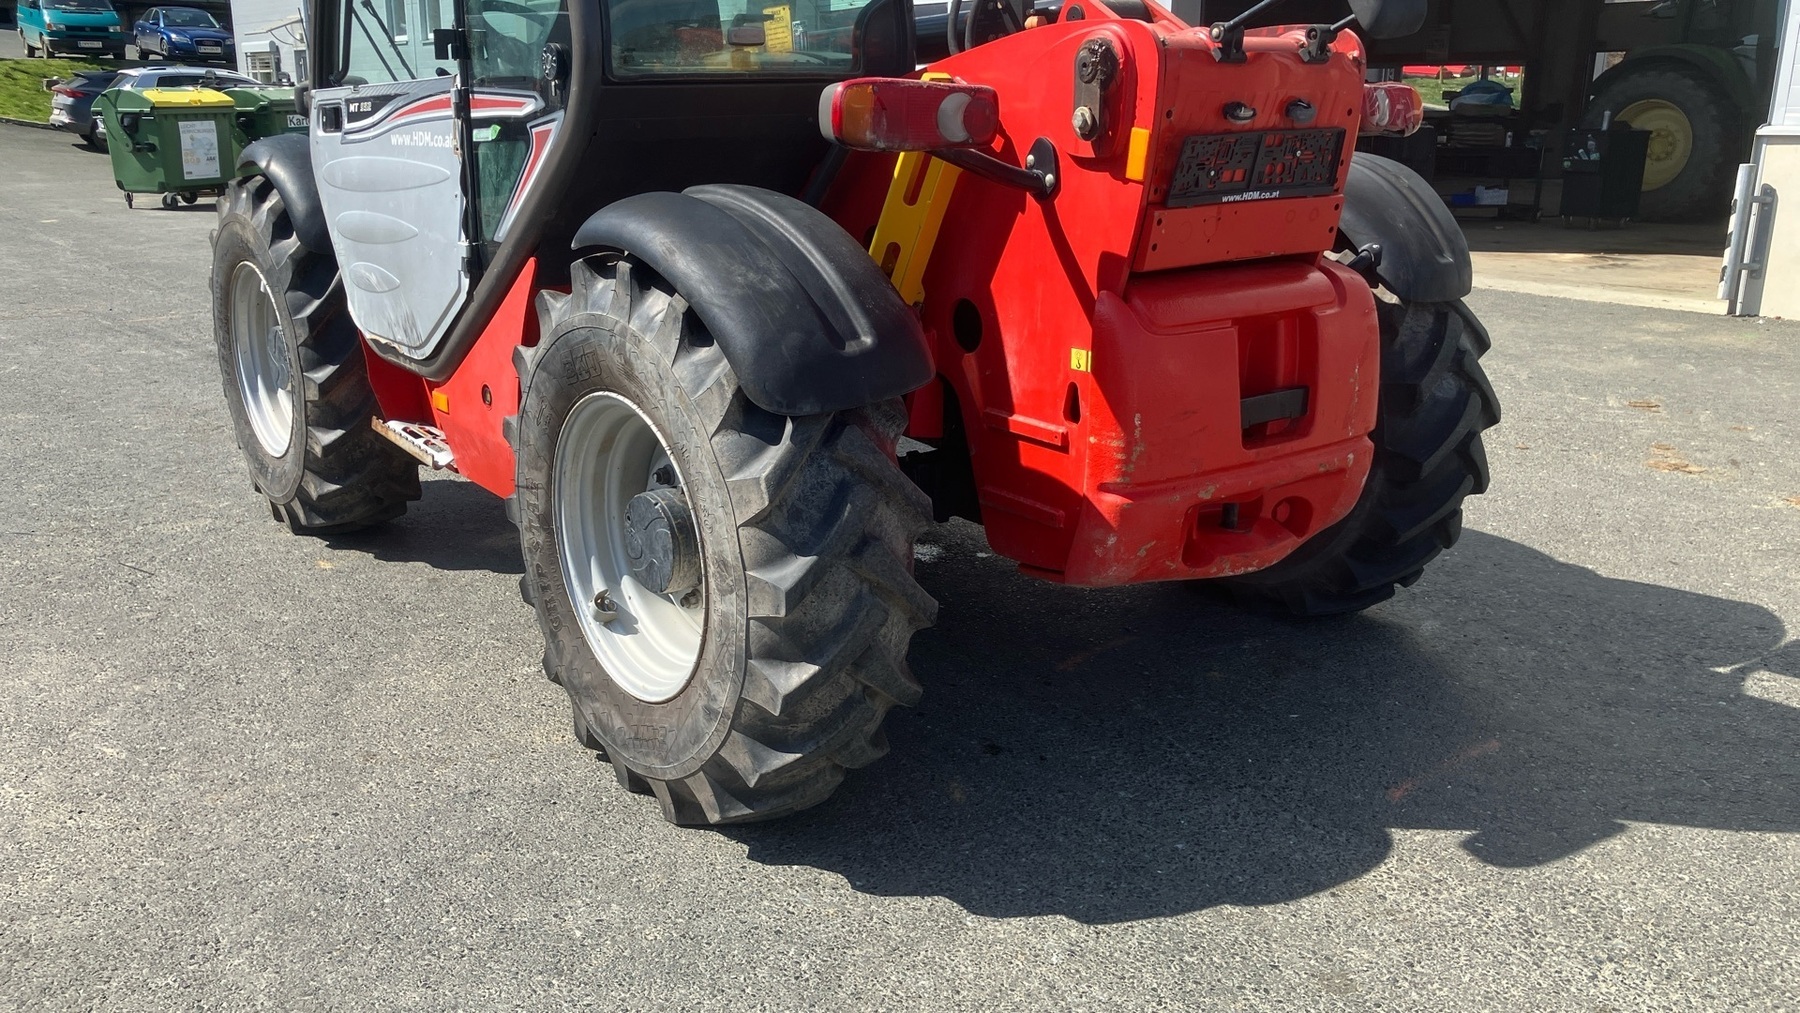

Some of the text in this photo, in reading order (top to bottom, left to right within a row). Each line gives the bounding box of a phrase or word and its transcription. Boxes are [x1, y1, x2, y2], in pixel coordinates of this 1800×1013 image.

[349, 102, 360, 113] MT
[390, 131, 453, 148] www.HDM.co.at
[1221, 190, 1280, 203] www.HDM.co.at
